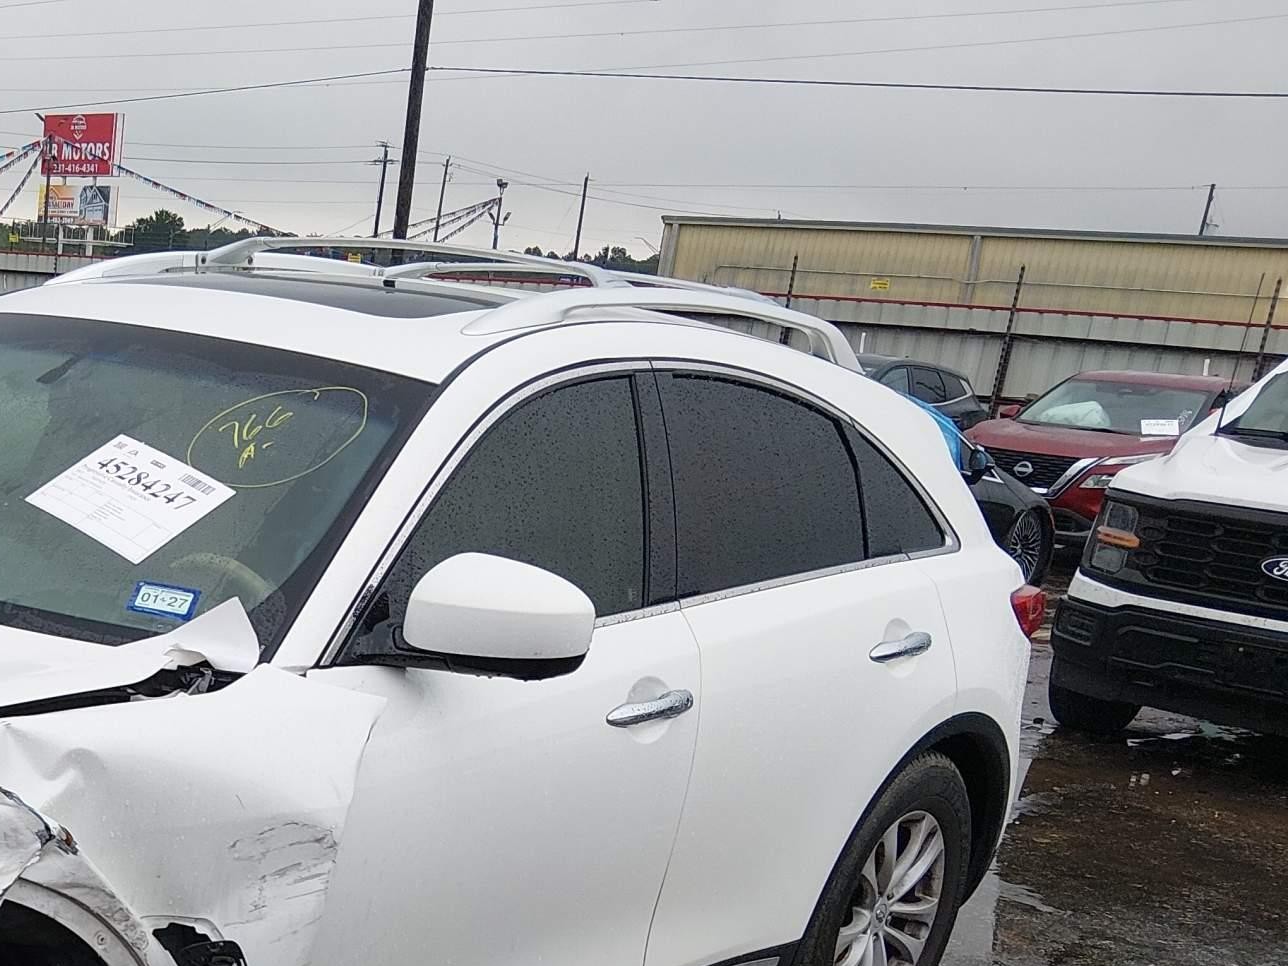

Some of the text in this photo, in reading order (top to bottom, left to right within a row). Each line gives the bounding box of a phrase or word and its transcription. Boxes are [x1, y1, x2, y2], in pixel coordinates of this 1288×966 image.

[62, 142, 109, 160] MOTORS
[219, 406, 293, 448] 766
[97, 457, 197, 510] 45284247
